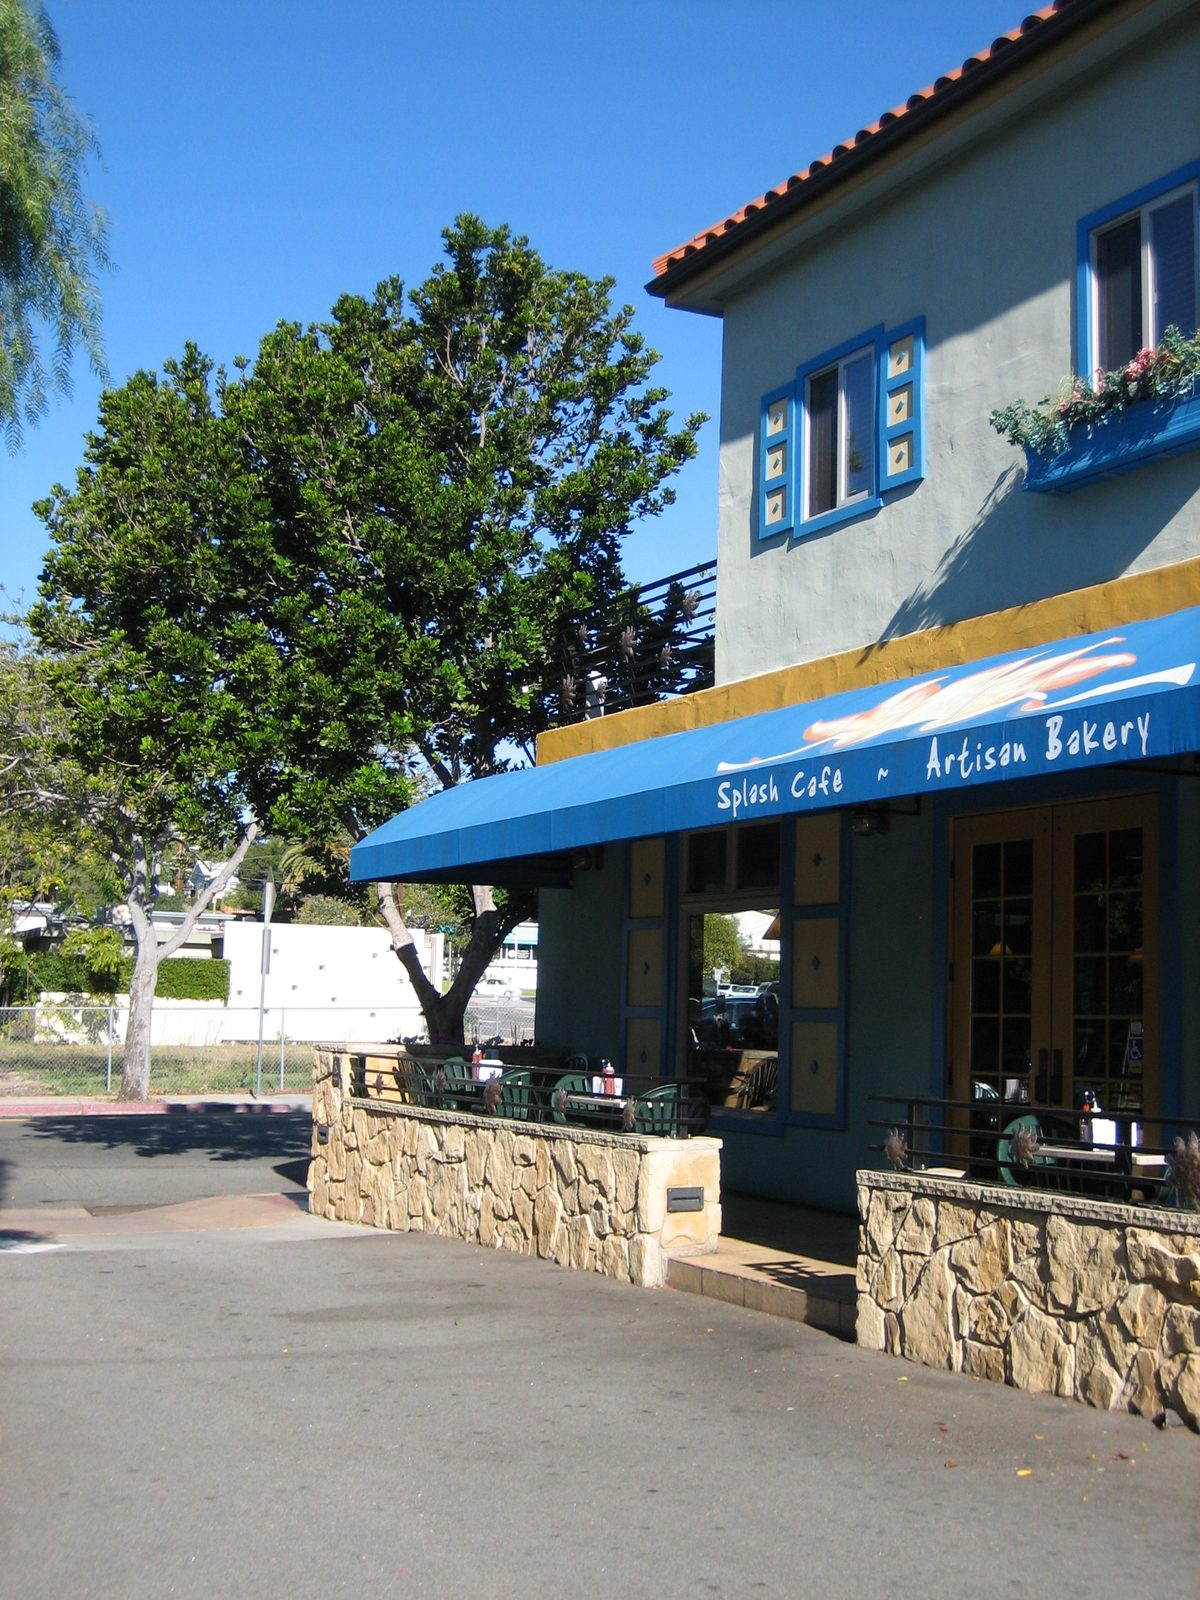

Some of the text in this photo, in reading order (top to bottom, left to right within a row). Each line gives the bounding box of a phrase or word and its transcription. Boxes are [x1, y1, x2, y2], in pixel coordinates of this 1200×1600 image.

[717, 774, 779, 818] Splash
[790, 766, 844, 799] Cafe
[926, 736, 1028, 780] Artisan
[1045, 712, 1151, 761] Bakery
